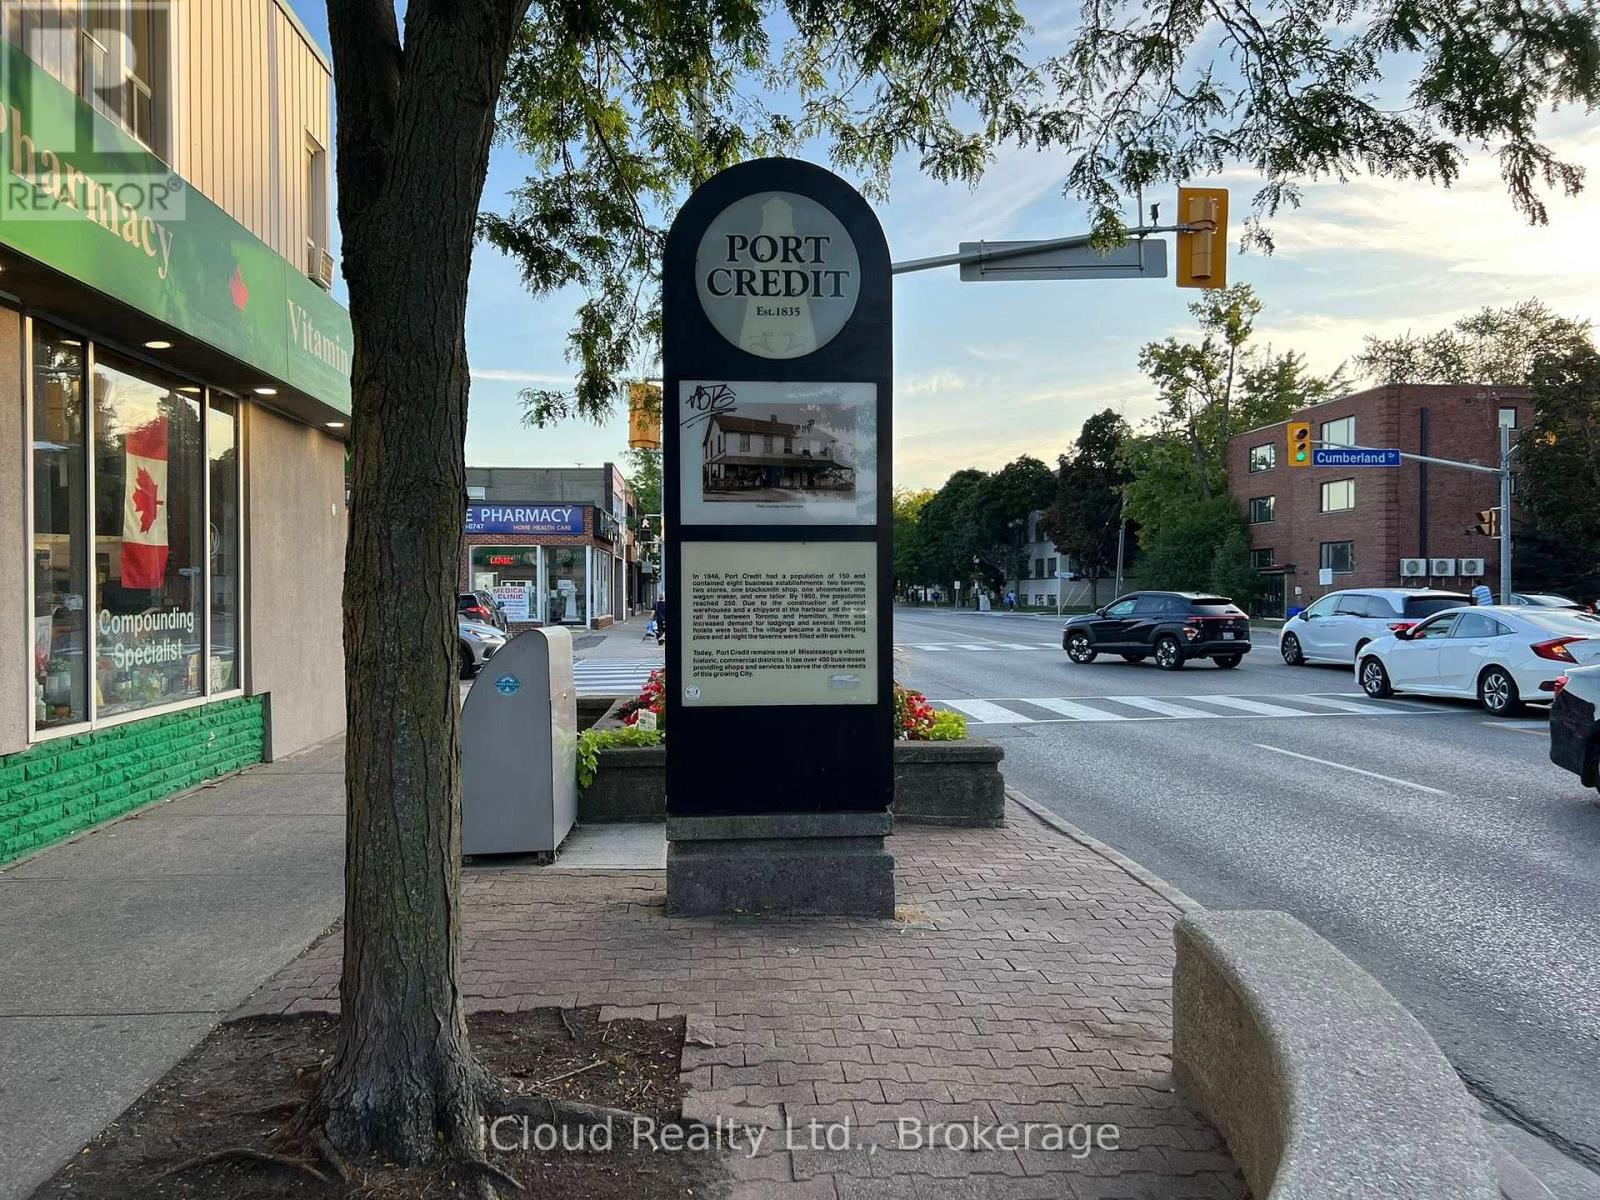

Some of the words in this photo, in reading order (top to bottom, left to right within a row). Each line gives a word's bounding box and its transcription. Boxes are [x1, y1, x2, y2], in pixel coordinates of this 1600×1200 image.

[725, 234, 831, 264] PORT
[706, 268, 850, 298] CREDIT
[756, 306, 801, 317] Est.1835
[1317, 452, 1386, 463] Cumberland
[481, 508, 572, 522] PHARMACY
[100, 606, 194, 637] Compounding
[114, 639, 182, 672] Specialist
